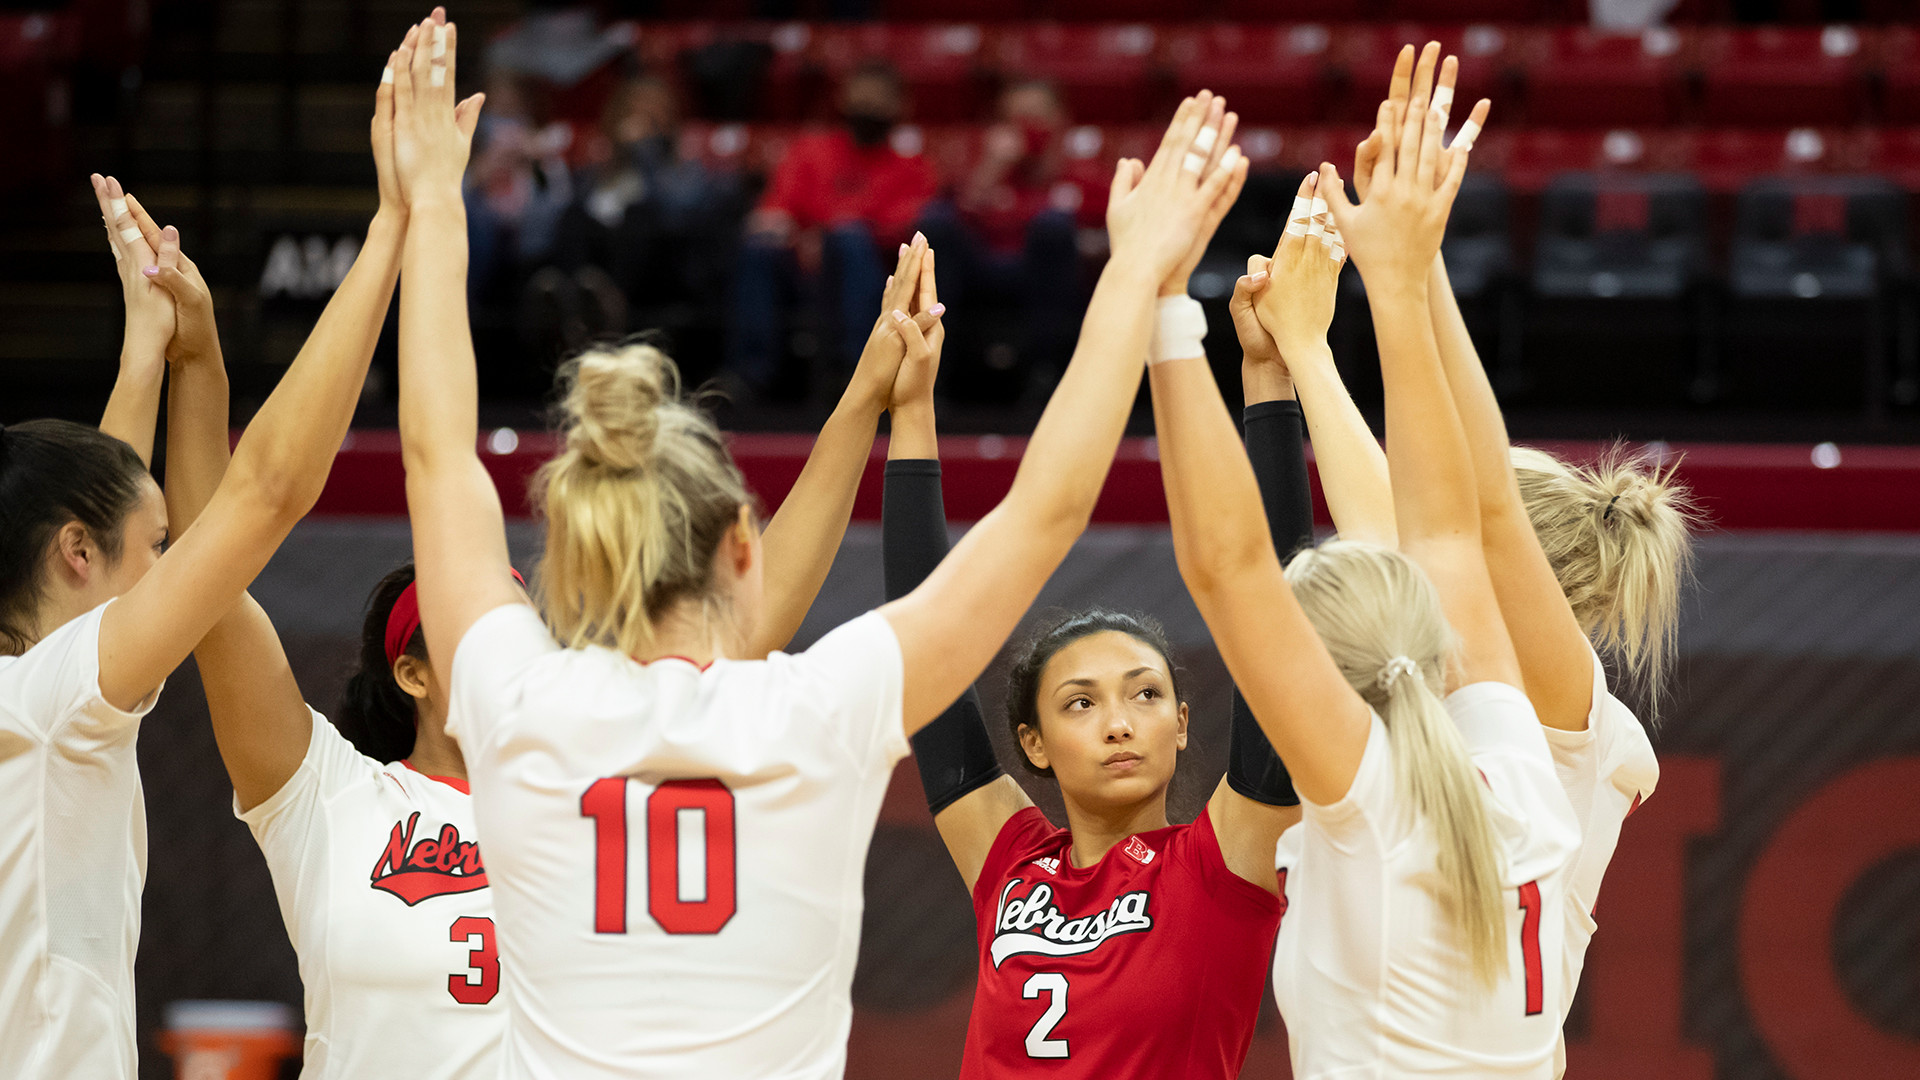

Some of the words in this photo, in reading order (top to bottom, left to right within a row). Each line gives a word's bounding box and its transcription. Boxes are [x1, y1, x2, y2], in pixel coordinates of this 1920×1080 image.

[581, 776, 737, 935] 10
[448, 916, 500, 1005] 3
[1022, 973, 1070, 1059] 2
